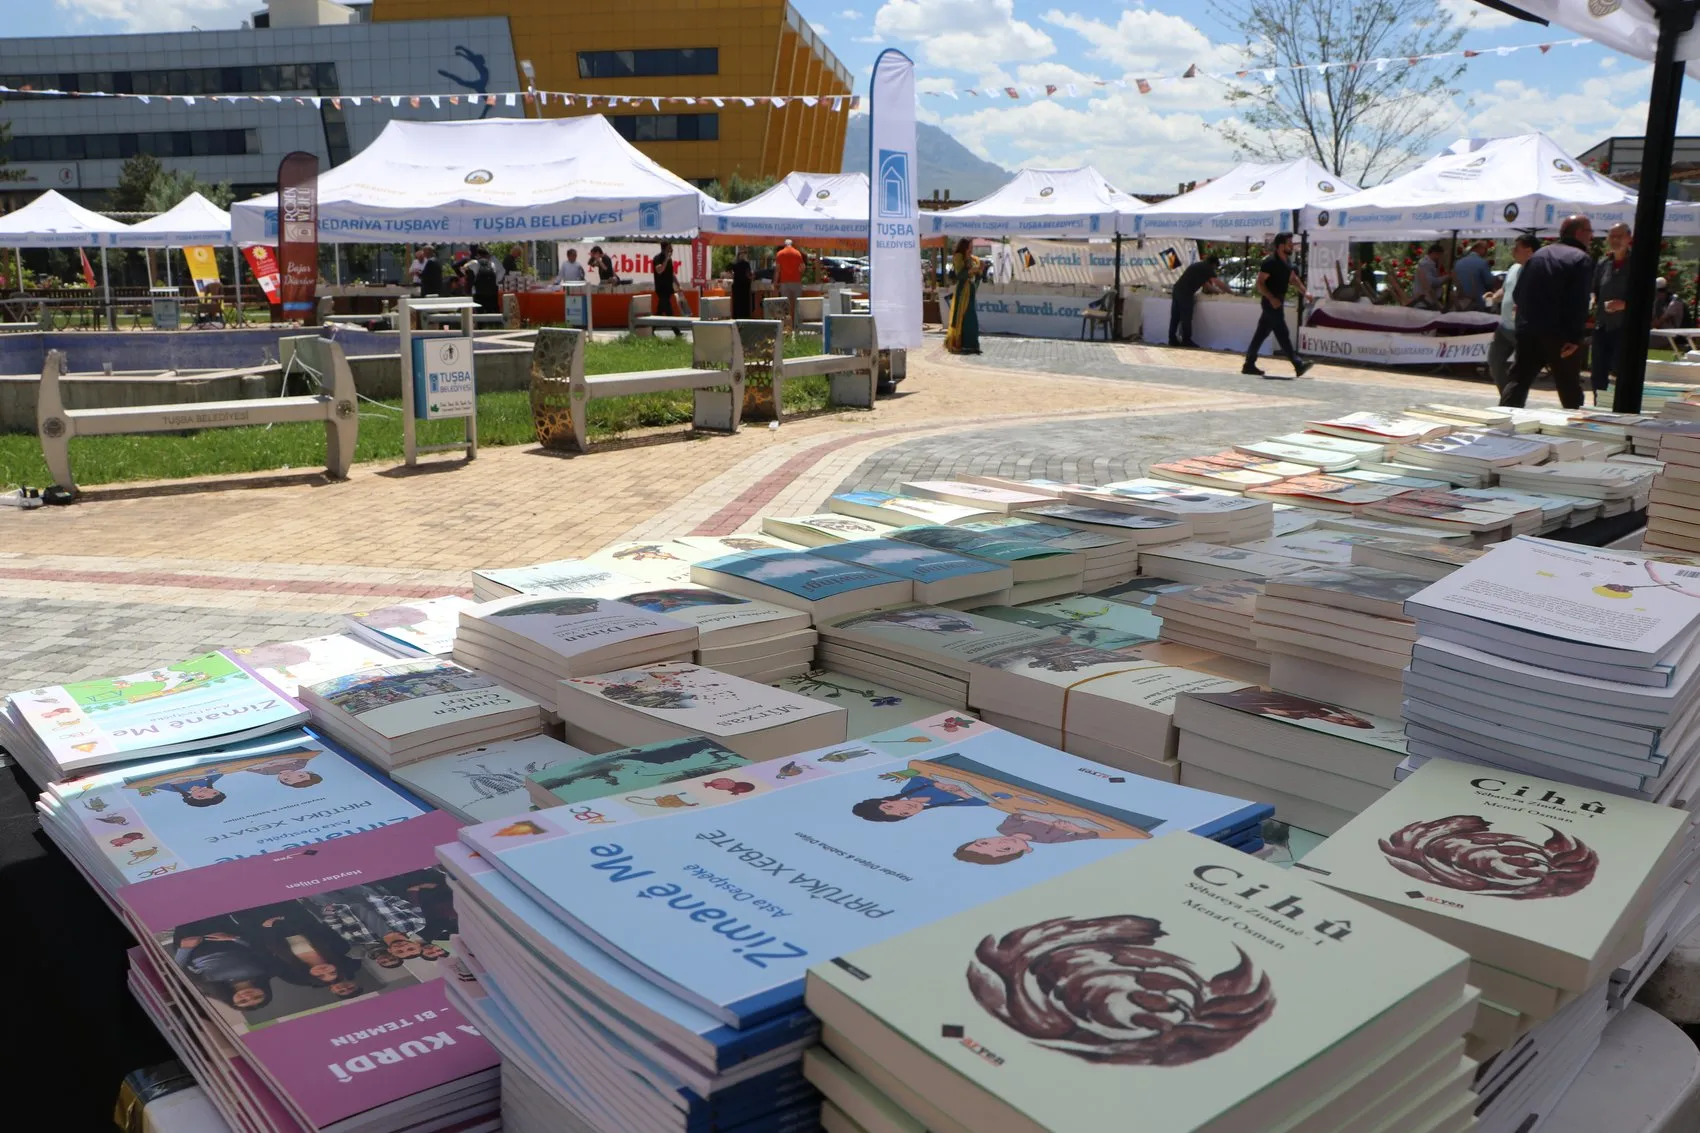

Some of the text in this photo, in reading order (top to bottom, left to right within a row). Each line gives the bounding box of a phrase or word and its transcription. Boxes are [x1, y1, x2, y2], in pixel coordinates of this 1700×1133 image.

[318, 216, 449, 233] REDARÎYA TUŞBAYÊ
[473, 209, 623, 233] TUŞBA BELEDİYESİ
[877, 223, 914, 239] TUŞBA
[876, 239, 915, 249] BELEDİYESİ
[1039, 254, 1081, 267] pirtuk
[440, 371, 471, 384] TUŞBA
[170, 699, 280, 730] Zimanê
[113, 725, 160, 738] Me
[1470, 777, 1608, 816] Cihû
[570, 805, 617, 825] ABC
[1483, 801, 1574, 823] Menaf Osman
[1526, 801, 1578, 815] Zindanê
[205, 800, 372, 843] PIRTÛKA XEBATÊ
[322, 819, 352, 830] Asta
[138, 862, 179, 879] ABC
[285, 869, 363, 890] Haydar Diljen
[695, 829, 896, 920] PIRTÛKA XEBATÊ
[682, 863, 793, 919] Asta Destpêkê
[1424, 895, 1465, 909] aryen
[590, 842, 809, 969] Zimanê Me
[1193, 864, 1353, 942] Cihû
[1182, 899, 1286, 950] Menaf Osman
[1245, 907, 1304, 936] Zindanê
[415, 1010, 438, 1023] BI
[330, 1017, 414, 1047] TEMRÎN
[328, 1031, 457, 1084] KURDÎ
[959, 1036, 1006, 1067] aryen
